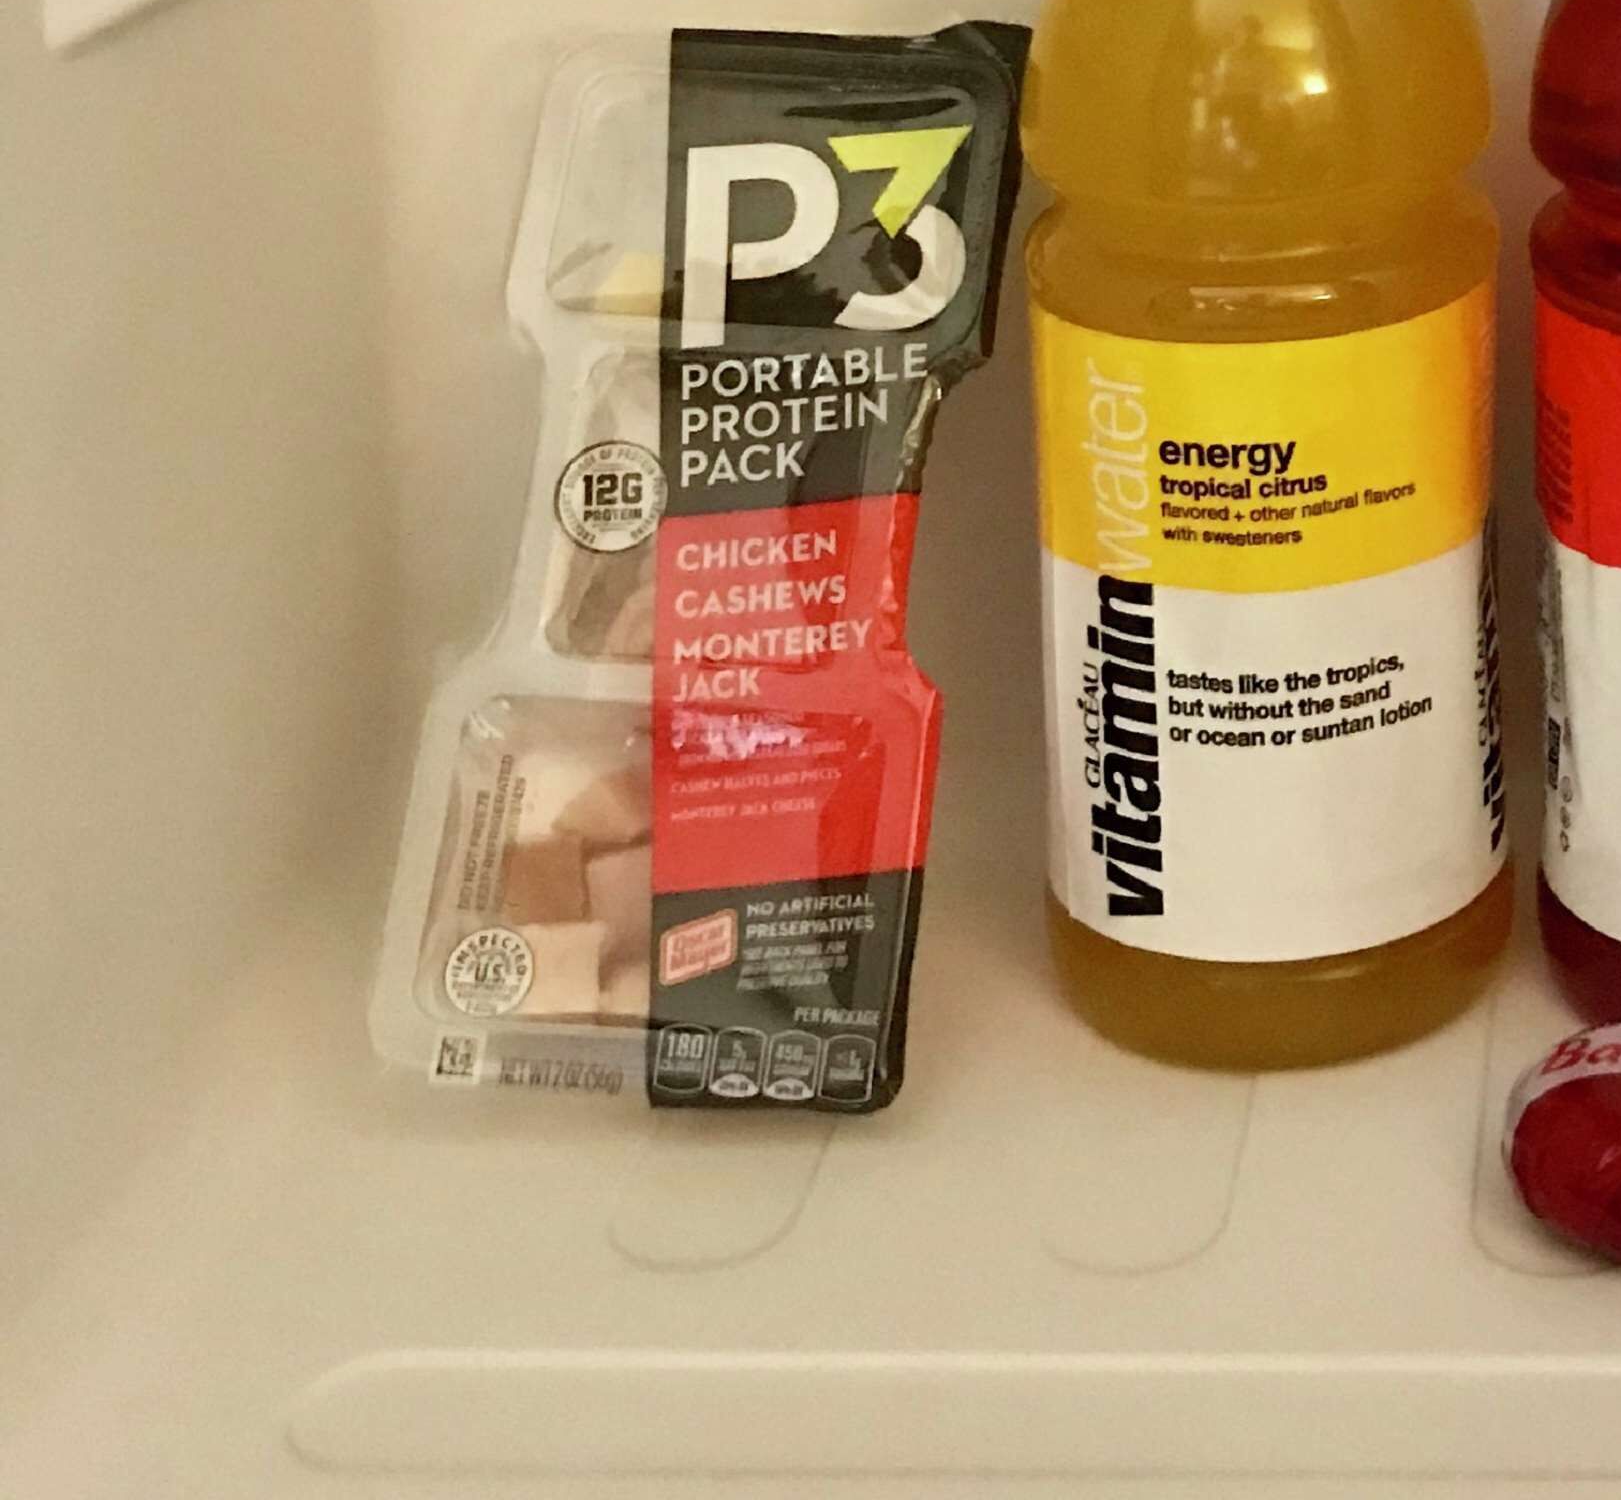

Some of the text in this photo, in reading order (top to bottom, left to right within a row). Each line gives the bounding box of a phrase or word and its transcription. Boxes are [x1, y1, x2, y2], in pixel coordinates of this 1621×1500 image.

[681, 124, 974, 350] P3
[681, 343, 929, 401] PORTABLE
[681, 388, 888, 445] PROTEIN
[680, 440, 806, 488] PACK
[1159, 439, 1297, 476] energy
[582, 472, 643, 507] 12G
[1159, 473, 1328, 501] tropical citrus
[1160, 501, 1229, 521] flavored
[1249, 505, 1297, 522] other
[1301, 491, 1359, 518] natural
[1363, 481, 1416, 506] flavors
[583, 507, 643, 522] PROTEIN
[676, 528, 838, 572] CHICKEN
[1162, 527, 1303, 546] with sweeteners
[674, 575, 848, 619] CASHEWS
[672, 617, 874, 665] MONTEREY
[672, 668, 762, 703] JACK
[1166, 654, 1405, 694] tastes like the tropics,
[1168, 680, 1391, 721] but without the sand
[1169, 696, 1433, 747] or ocean or suntan lotion
[747, 892, 876, 918] NO ARTIFICIAL
[746, 914, 876, 940] PRESERVATIVES
[667, 1032, 706, 1059] 180
